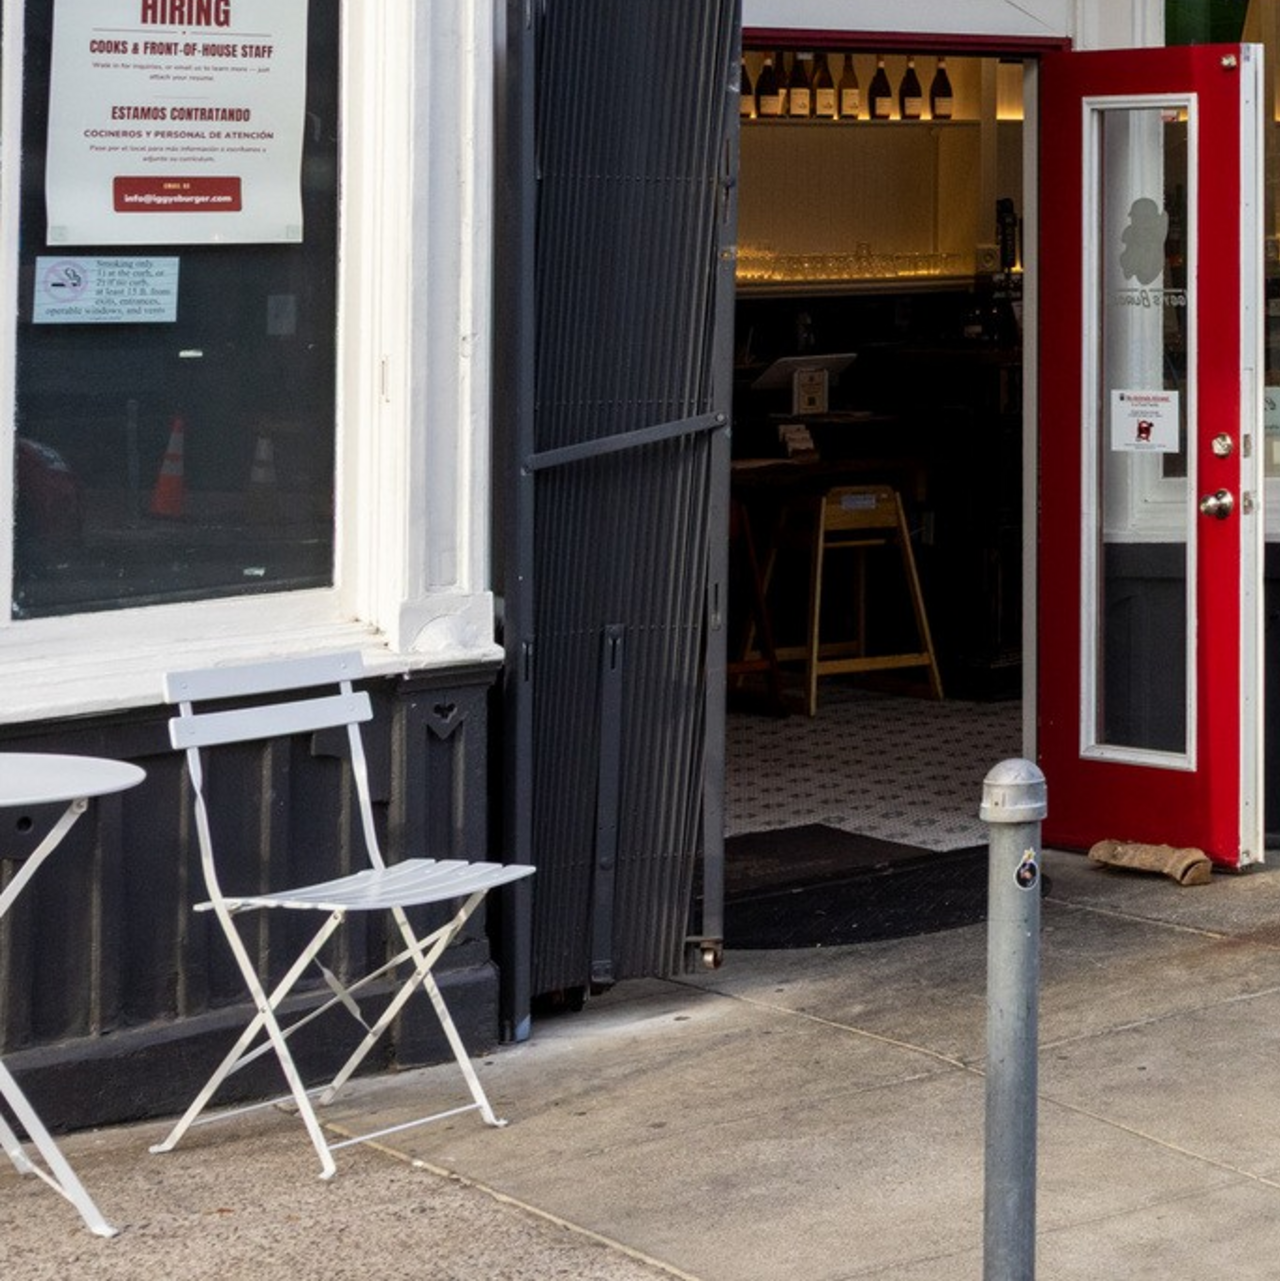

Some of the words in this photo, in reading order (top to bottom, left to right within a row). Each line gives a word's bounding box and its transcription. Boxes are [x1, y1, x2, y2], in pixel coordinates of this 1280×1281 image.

[89, 39, 128, 54] COOKS
[131, 41, 139, 55] &
[143, 41, 238, 58] FRONT-OF-HOUSE
[241, 44, 273, 59] STAFF
[111, 106, 167, 121] ESTAMOS
[170, 107, 251, 122] CONTRATANDO
[83, 129, 143, 138] COCINEROS
[146, 130, 152, 138] Y
[154, 130, 206, 139] PERSONAL
[209, 131, 222, 139] DE
[224, 130, 274, 140] ATENCIÓN
